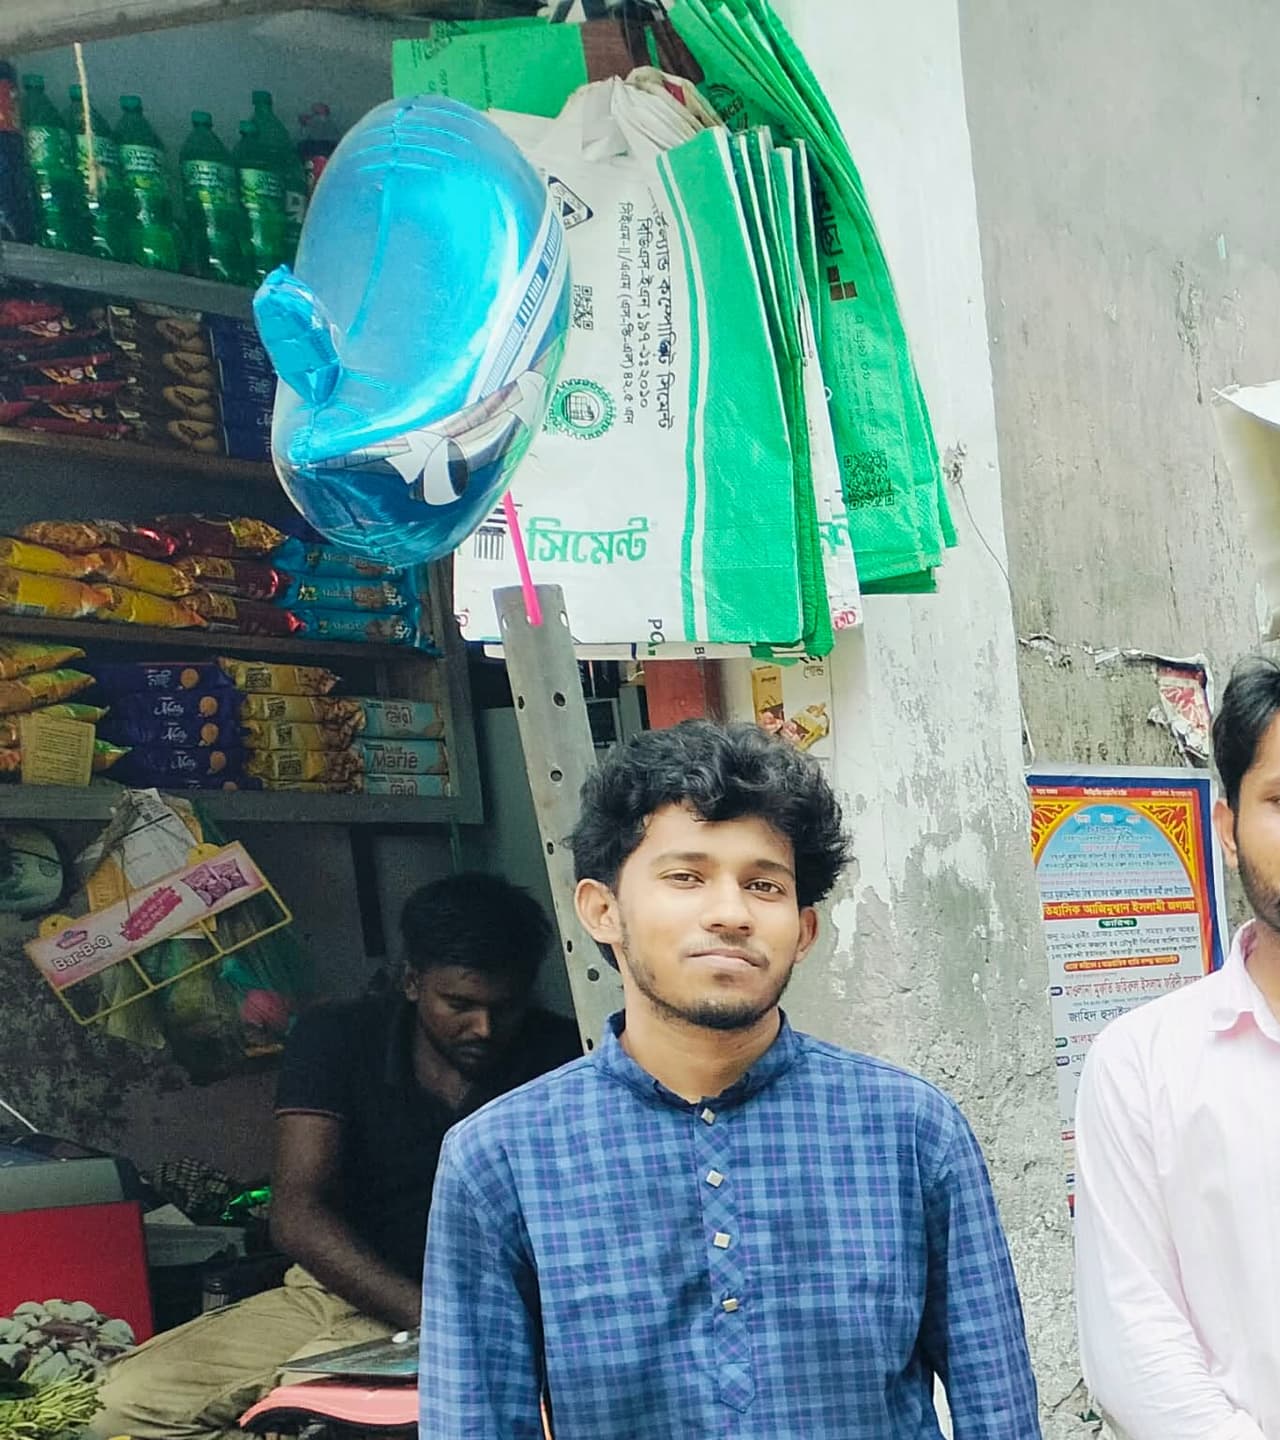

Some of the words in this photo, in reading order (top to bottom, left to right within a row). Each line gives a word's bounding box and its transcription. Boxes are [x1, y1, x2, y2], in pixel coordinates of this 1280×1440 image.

[526, 516, 649, 564] সিমেন্ট
[371, 747, 418, 770] Marie
[52, 934, 112, 971] Bar-B-Q
